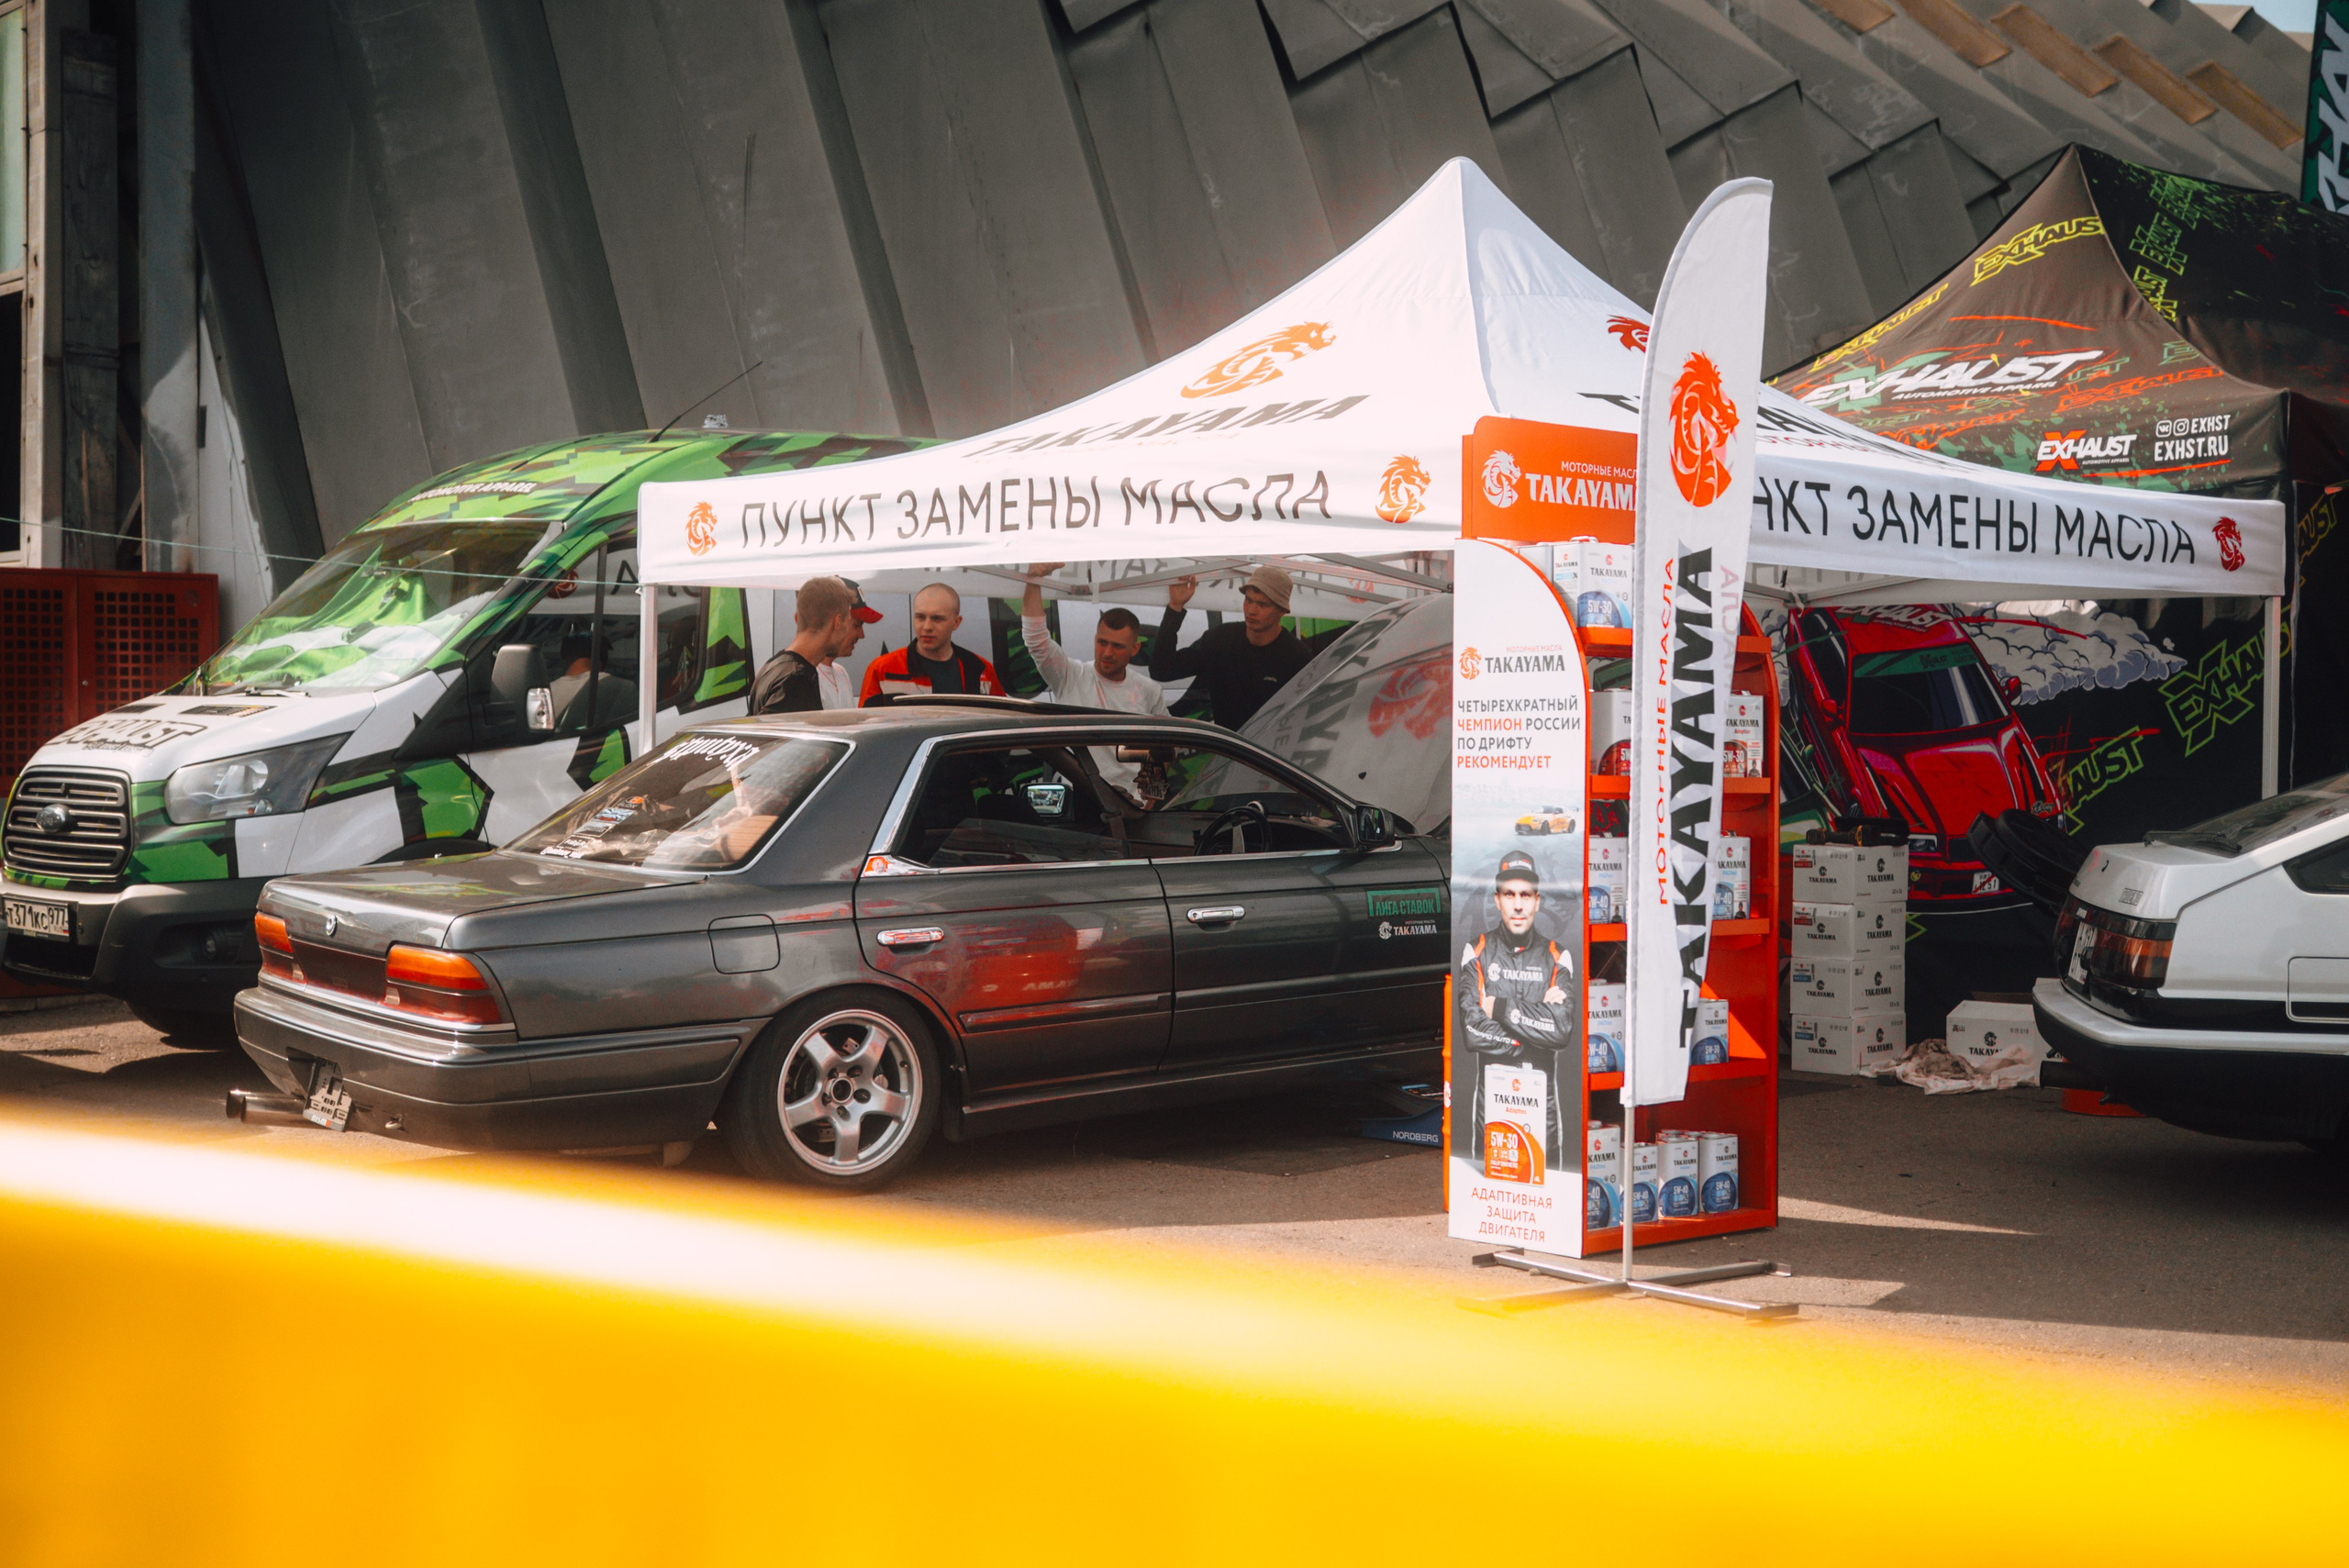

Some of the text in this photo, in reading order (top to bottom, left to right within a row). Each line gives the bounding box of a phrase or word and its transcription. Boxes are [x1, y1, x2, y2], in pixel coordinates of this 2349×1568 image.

[1970, 216, 2105, 287] EXHAUS
[1799, 350, 2104, 406] EXHAUST
[1891, 382, 2058, 401] AUTOMOTIVE APPAREL
[961, 395, 1372, 458] TAKAYAMA
[2190, 415, 2231, 434] EXHST
[2036, 430, 2137, 467] EXHAUST
[2154, 435, 2229, 462] EXHST.RU
[1561, 461, 1637, 479] МОТОРНЫЕ МАСЛ
[1525, 473, 1636, 512] TAKAYAM
[741, 470, 1332, 549] ПУНКТ ЗАМЕНЫ МАСЛА
[1753, 476, 2195, 564] НКТ ЗАМЕНЫ МАСЛА
[1590, 567, 1628, 578] TAKAYAMA
[1587, 599, 1612, 615] 5W-30
[1659, 558, 1674, 686] МАСЛА
[1485, 655, 1566, 673] TAKAYAMA
[1458, 695, 1578, 713] ЧЕТЫРЕХКРАТНЫЙ
[1458, 717, 1581, 731] ЧЕМПИОН РОССИИ
[1457, 737, 1532, 751] ПО ДРИФТУ
[1457, 756, 1552, 770] РЕКОМЕНДУЕТ
[1669, 547, 1714, 1048] TAKAYAMA
[1718, 861, 1746, 869] AKAYAMA
[1867, 873, 1895, 883] TAKAYAMA
[1376, 898, 1435, 916] ЛИГА СТАВОК
[1714, 892, 1732, 906] W-40
[48, 906, 65, 928] 977
[1394, 924, 1438, 936] TAKAYAMA
[1866, 930, 1892, 939] TAKAYAMA
[1503, 968, 1543, 982] TAKAYAMA
[1807, 990, 1834, 998] TAKAYAMA
[1865, 986, 1891, 996] TAKAYAMA
[1520, 1015, 1555, 1032] TAKAYAMA
[1809, 1047, 1836, 1055] TAKAYAMA
[1867, 1042, 1893, 1053] TAKAYAMA
[1969, 1047, 2003, 1056] TAKAY
[1494, 1094, 1539, 1107] TAKAYAMA
[1393, 1130, 1439, 1143] NORDBERG
[1490, 1131, 1519, 1150] 5W-30
[1588, 1152, 1616, 1162] KAYAMA
[1674, 1158, 1697, 1166] TAKAYAMA
[1588, 1186, 1600, 1200] -40
[1674, 1184, 1689, 1195] 5W-40
[1716, 1180, 1731, 1191] 5W-40
[1471, 1187, 1553, 1209] АДАПТИВНАЯ
[1486, 1206, 1536, 1224] ЗАЩИТА
[1478, 1221, 1545, 1242] ДВИГАТЕЛЯ
